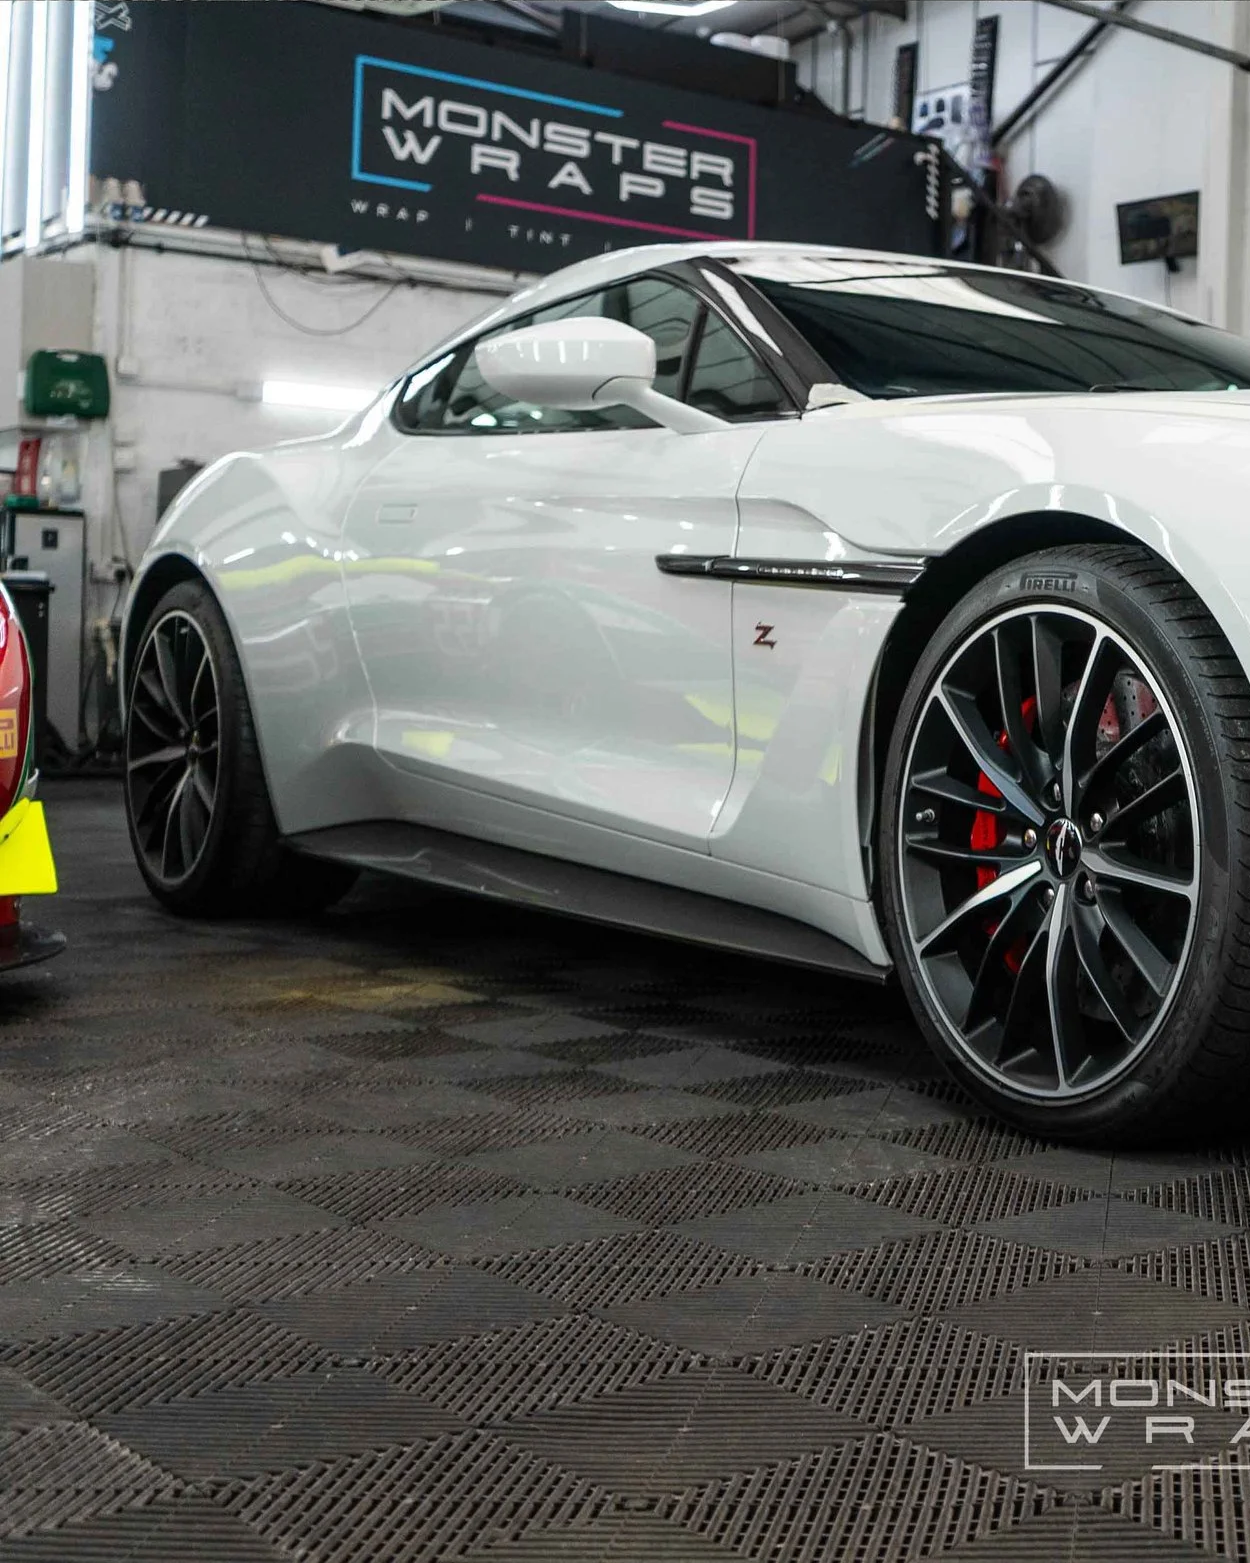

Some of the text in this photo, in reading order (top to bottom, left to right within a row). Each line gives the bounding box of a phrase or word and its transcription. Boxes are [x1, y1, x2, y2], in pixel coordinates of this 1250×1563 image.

[381, 87, 734, 187] MONSTER
[381, 125, 735, 221] WRAPS
[350, 198, 572, 247] WRAP TINT
[1020, 570, 1078, 592] PIRELLI
